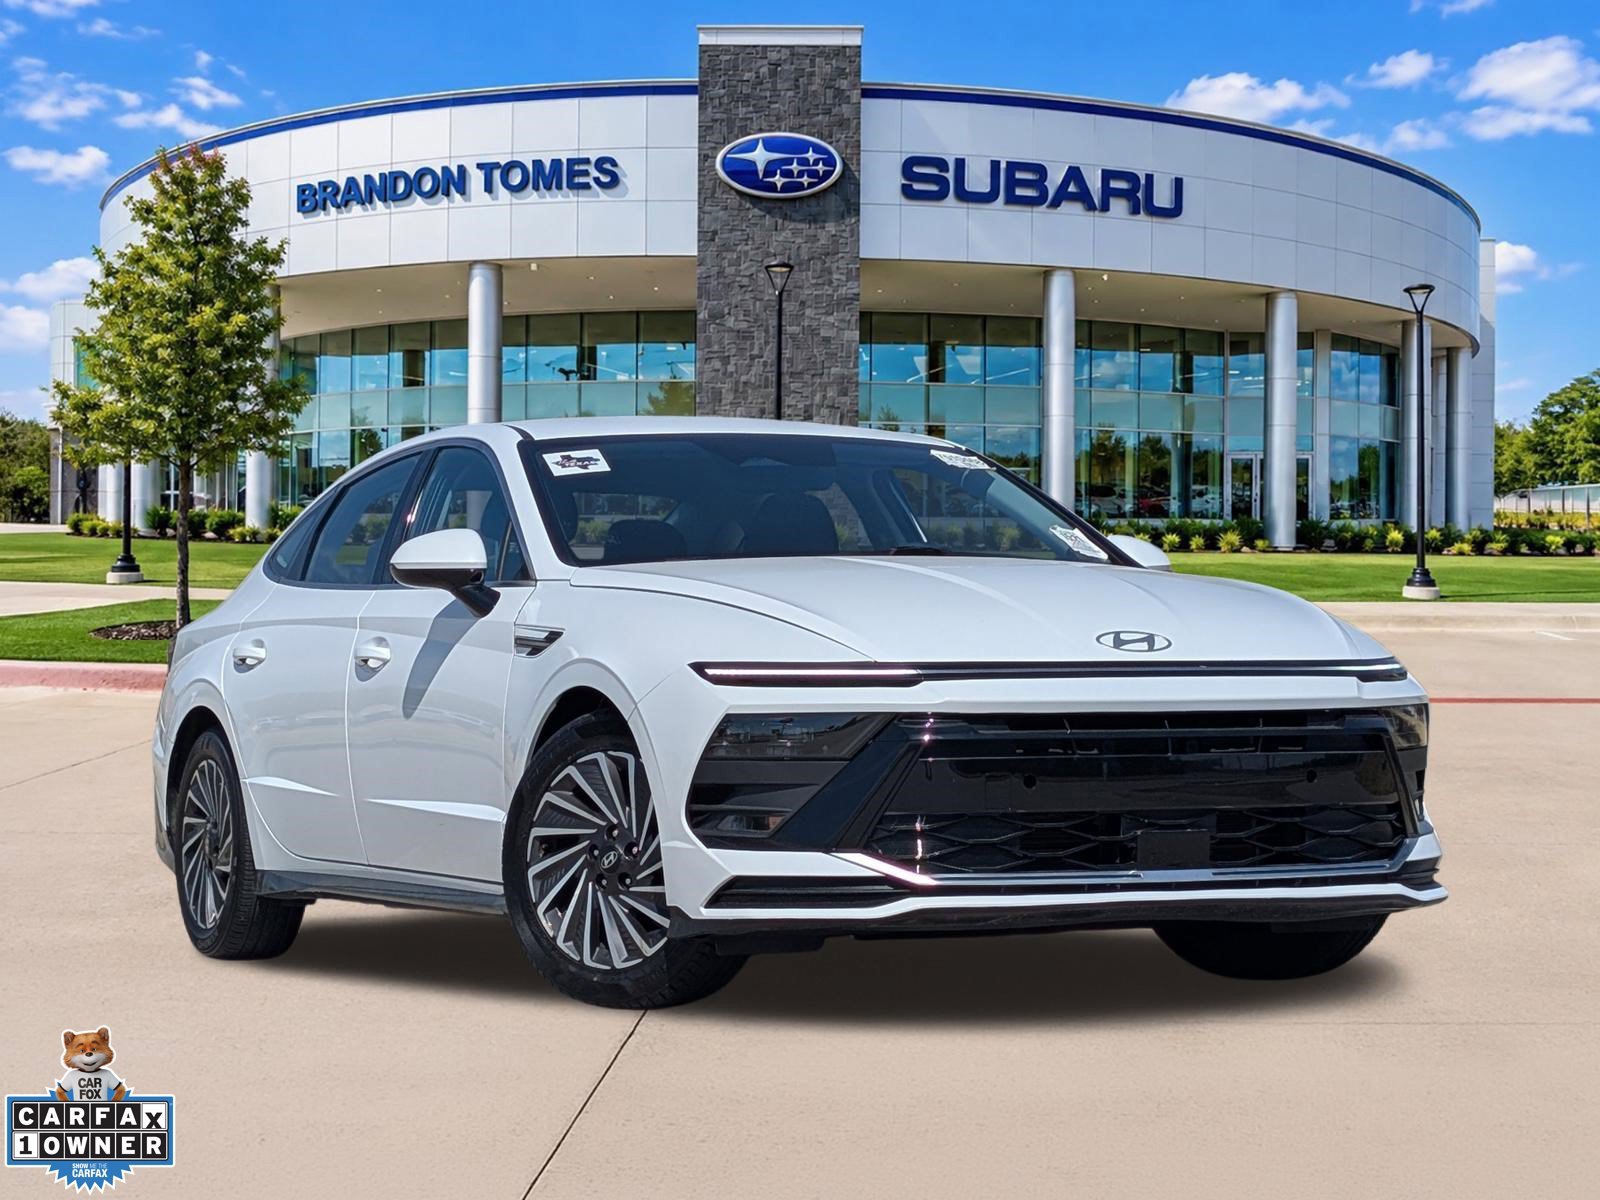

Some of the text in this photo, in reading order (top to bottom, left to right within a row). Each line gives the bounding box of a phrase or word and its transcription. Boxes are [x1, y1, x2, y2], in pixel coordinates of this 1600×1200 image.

[296, 156, 621, 213] BRANDON TOMES
[901, 155, 1183, 218] SUBARU
